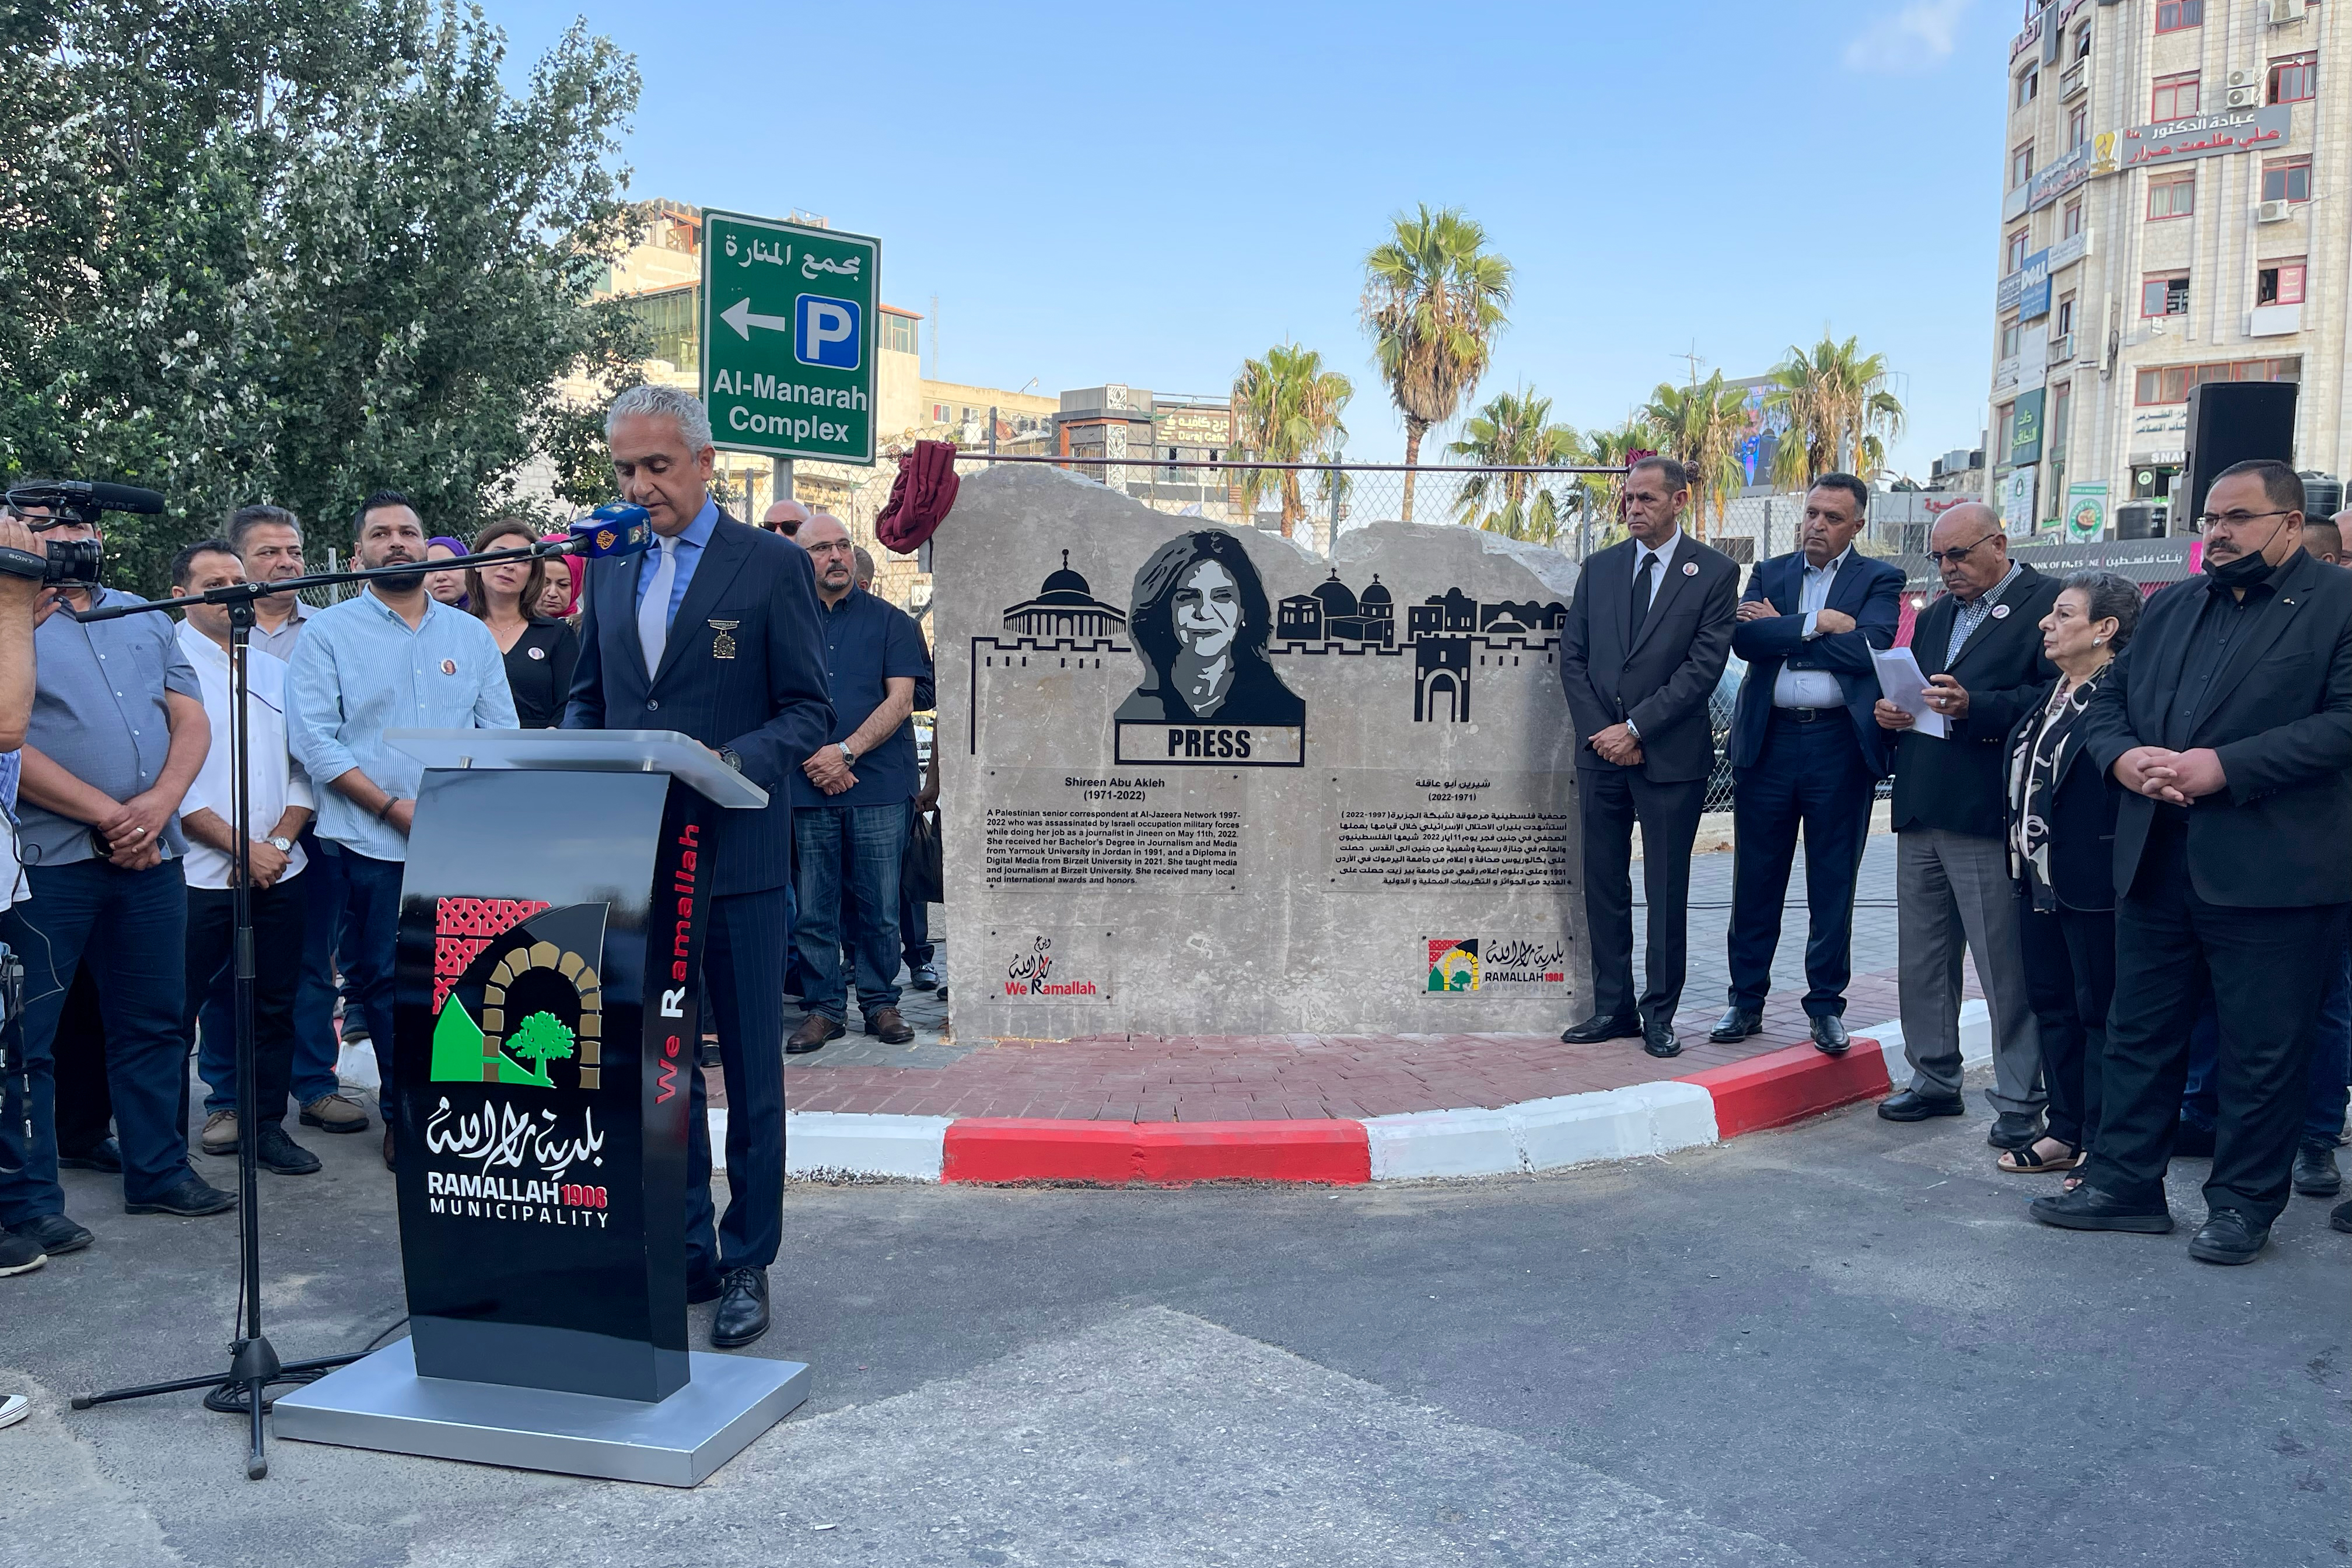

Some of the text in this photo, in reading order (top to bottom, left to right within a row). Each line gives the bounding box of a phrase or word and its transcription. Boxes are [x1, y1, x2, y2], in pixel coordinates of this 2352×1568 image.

[2209, 113, 2255, 128] عيادة
[2152, 117, 2206, 139] الدكتور
[2177, 131, 2234, 152] طلعت
[2239, 127, 2281, 149] علي
[725, 235, 861, 282] مجمع المنارة
[2021, 261, 2048, 291] DELL
[806, 300, 852, 360] P
[713, 369, 867, 411] Al-Manarah
[729, 405, 849, 443] Complex
[1178, 415, 1210, 429] كافيه
[1178, 430, 1202, 443] Daraj
[9, 553, 34, 564] SONY
[2106, 554, 2182, 567] بنك فلسطين
[2049, 561, 2060, 569] OF
[1168, 729, 1251, 758] PRESS
[1065, 776, 1165, 788] Shireen Abu Akleh
[1444, 778, 1457, 788] أبو
[1459, 779, 1490, 788] شيرين
[1083, 789, 1146, 803] (1971-2022)
[986, 808, 993, 817] A
[995, 808, 1040, 817] Palestinian
[1042, 809, 1068, 817] senior
[1069, 810, 1129, 819] correspondent
[1139, 810, 1182, 818] Al-Jazeera
[1045, 819, 1097, 827] assassinated
[1099, 819, 1110, 829] by
[1137, 820, 1182, 829] occupation
[1183, 820, 1213, 830] military
[1214, 820, 1240, 829] forces
[1419, 823, 1463, 831] الإسرائيلي
[986, 828, 1009, 836] while
[1010, 828, 1034, 838] doing
[1051, 828, 1065, 838] job
[1085, 828, 1125, 838] journalist
[1178, 830, 1195, 839] May
[1394, 833, 1419, 841] شيعها
[1518, 834, 1531, 843] في
[1534, 835, 1566, 844] الصحفي
[986, 837, 1003, 845] She
[1059, 838, 1104, 846] Bachelor's
[1105, 838, 1135, 848] Degree
[1137, 838, 1145, 846] in
[1213, 839, 1237, 848] Media
[986, 846, 1006, 855] from
[1048, 847, 1090, 857] University
[1102, 848, 1132, 856] Jordan
[1133, 848, 1142, 856] in
[1167, 848, 1184, 856] and
[1192, 848, 1227, 858] Diploma
[1228, 849, 1237, 857] in
[986, 856, 1013, 866] Digital
[1015, 856, 1040, 864] Media
[1041, 856, 1061, 864] from
[1063, 857, 1089, 865] Birzeit
[1091, 857, 1133, 867] University
[1167, 858, 1183, 866] She
[1185, 858, 1211, 867] taught
[986, 866, 1002, 874] and
[1003, 866, 1049, 876] journalism
[1060, 866, 1088, 874] Birzeit
[1135, 867, 1152, 875] She
[1191, 869, 1213, 877] many
[1215, 867, 1235, 876] local
[986, 876, 1002, 884] and
[1004, 875, 1055, 884] international
[1057, 876, 1087, 884] awards
[1088, 876, 1104, 884] and
[654, 824, 700, 1104] We Ramallah
[1485, 972, 1564, 982] RAMALLAH 1908
[1005, 978, 1096, 995] We Ramallah
[428, 1171, 608, 1209] RAMALLAH 1908
[430, 1198, 608, 1228] MUNICIPALITY
